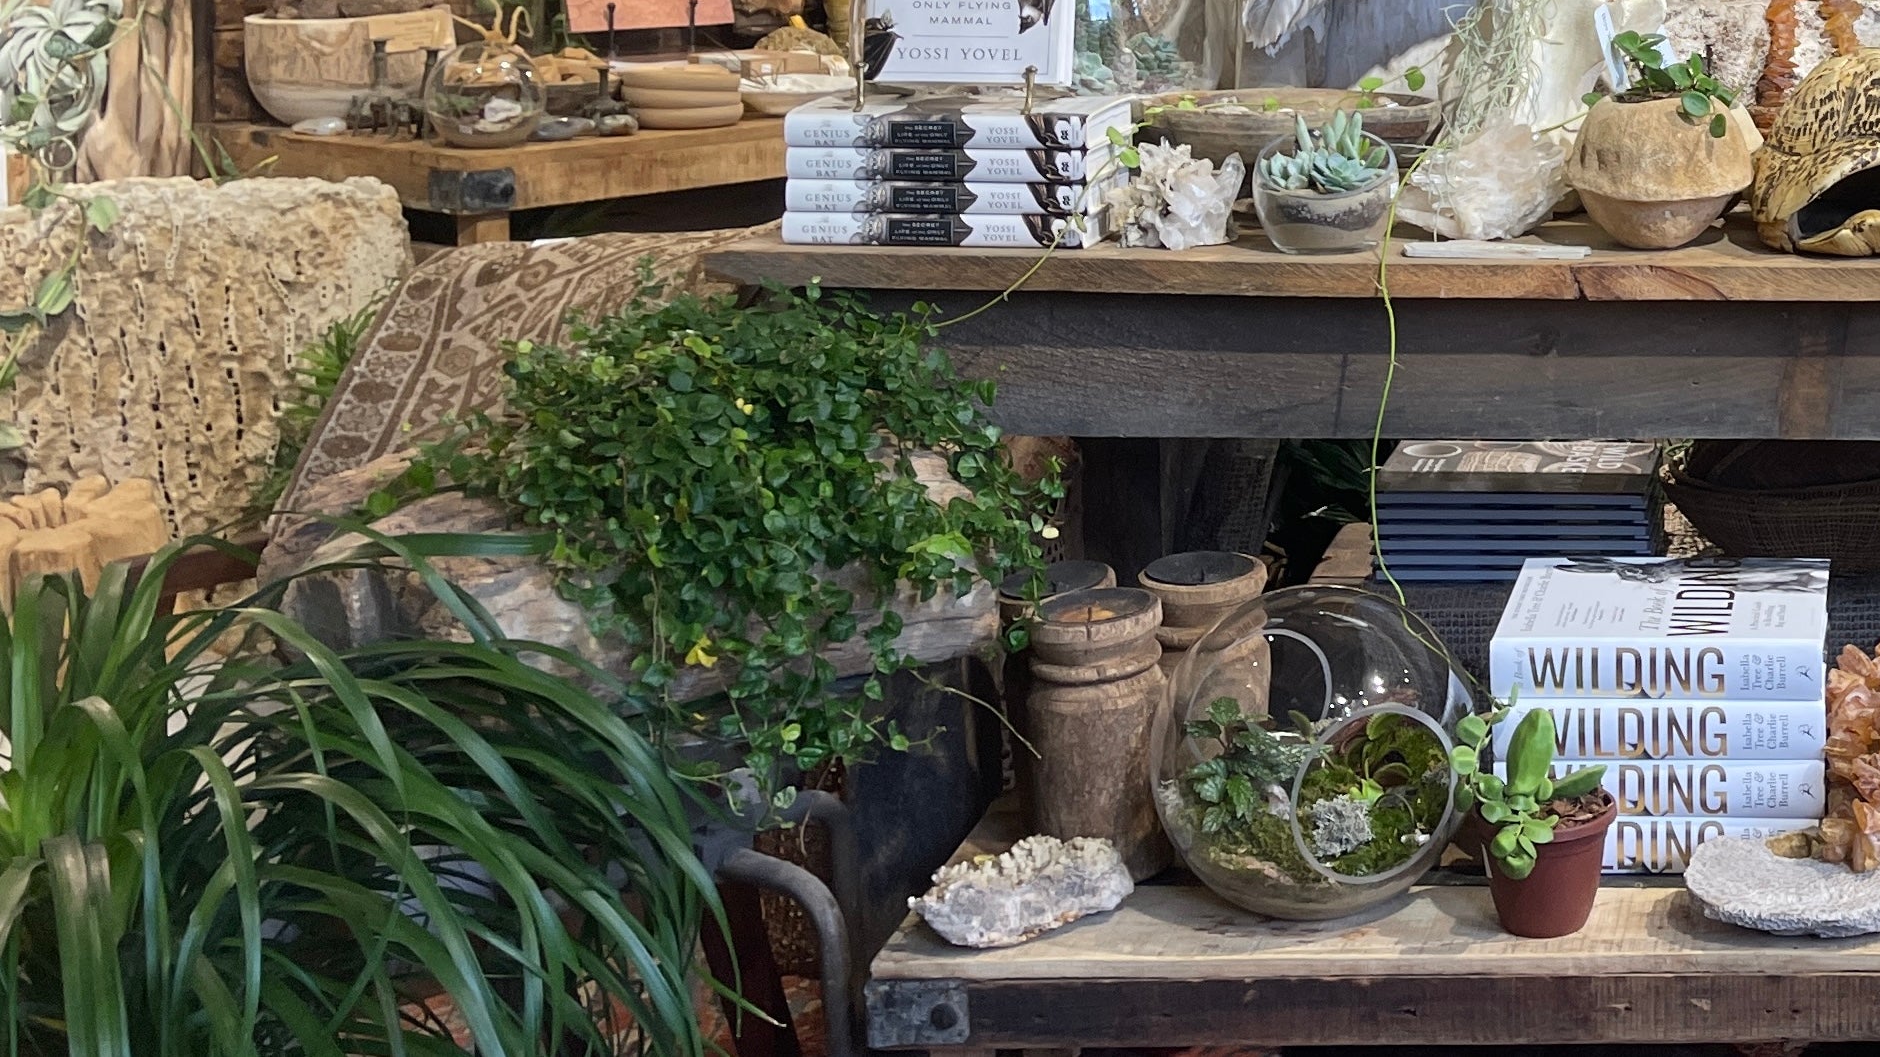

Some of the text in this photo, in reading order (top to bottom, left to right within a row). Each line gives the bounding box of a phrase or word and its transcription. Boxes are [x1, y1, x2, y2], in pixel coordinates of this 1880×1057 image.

[912, 1, 1011, 10] ONLY FLYING
[930, 16, 992, 25] MAMMAL
[897, 47, 1023, 61] YOSSI YOVEL
[804, 130, 850, 139] GENIUS
[986, 135, 1021, 144] YOVEL
[988, 126, 1018, 135] YOSSI
[806, 159, 852, 168] GENIUS
[987, 167, 1022, 175] YOVEL
[989, 158, 1019, 166] YOSSI
[805, 193, 852, 202] GENIUS
[988, 201, 1022, 209] YOVEL
[802, 225, 848, 233] GENIUS
[983, 233, 1018, 241] YOVEL
[985, 225, 1016, 233] YOSSI
[1597, 444, 1628, 469] WILD
[1639, 584, 1675, 631] The Book of
[1666, 558, 1742, 637] WILDING
[1528, 646, 1725, 696] WILDING
[1740, 654, 1750, 690] Isabella
[1752, 655, 1762, 689] Tree &
[1764, 655, 1774, 690] Charlie
[1776, 656, 1786, 689] Burrell
[1742, 713, 1752, 750] Isabella
[1754, 713, 1764, 749] Tree &
[1767, 714, 1777, 749] Charlie
[1779, 715, 1789, 748] Burrell
[1742, 772, 1752, 809] Isabella
[1754, 771, 1764, 807] Tree &
[1767, 772, 1777, 808] Charlie
[1779, 773, 1789, 807] Burrell
